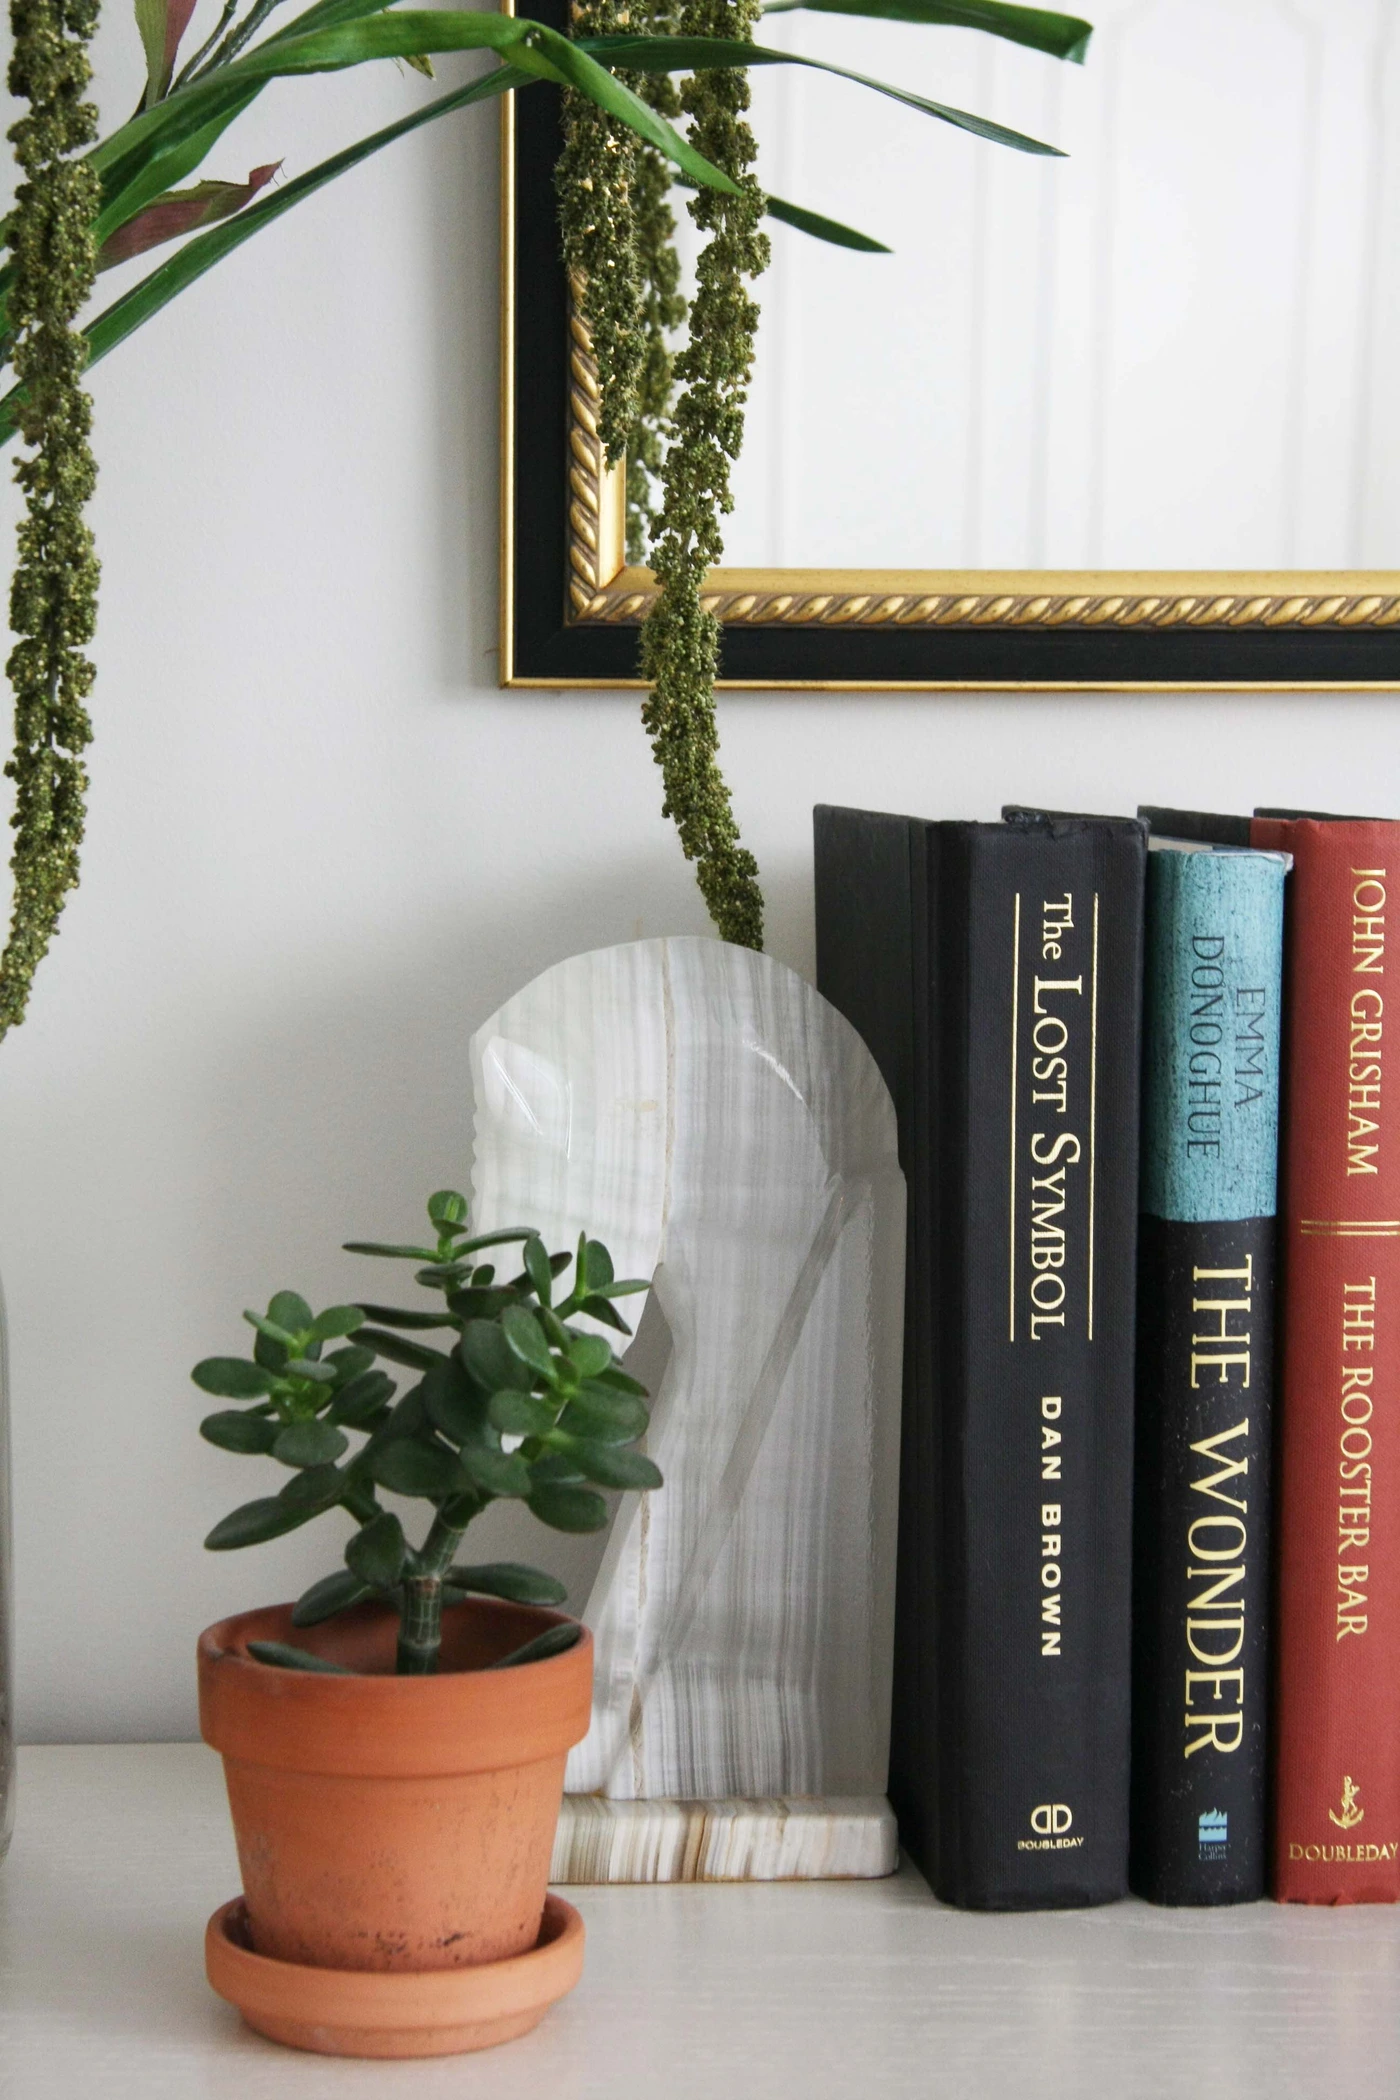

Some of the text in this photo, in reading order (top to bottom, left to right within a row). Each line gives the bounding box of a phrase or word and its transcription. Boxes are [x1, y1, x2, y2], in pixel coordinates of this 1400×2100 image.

[1030, 892, 1083, 1341] The LOST SYMBOL
[1187, 935, 1226, 1160] DONOGHUE
[1233, 987, 1267, 1108] EMMA
[1347, 867, 1386, 1177] JOHN GRISHAM
[1040, 1395, 1063, 1657] DAN BROWN
[1184, 1253, 1253, 1760] THE WONDER
[1335, 1276, 1377, 1644] THE ROOSTER BAR
[1017, 1836, 1085, 1851] DOUBLEDAY
[1289, 1842, 1399, 1862] DOUBLEDAY
